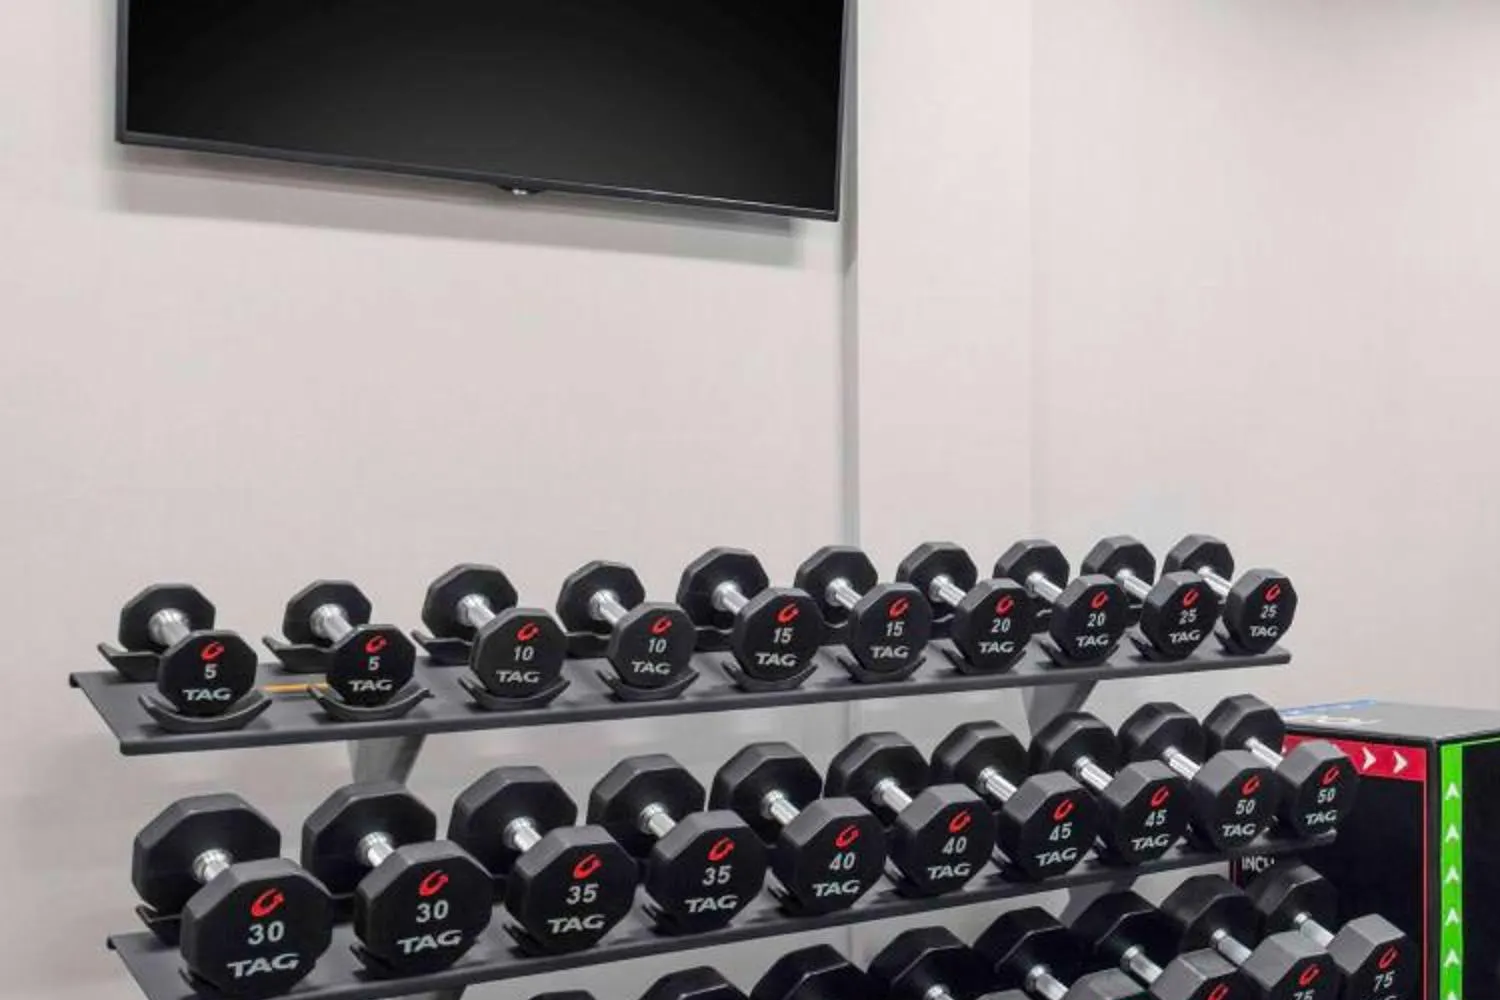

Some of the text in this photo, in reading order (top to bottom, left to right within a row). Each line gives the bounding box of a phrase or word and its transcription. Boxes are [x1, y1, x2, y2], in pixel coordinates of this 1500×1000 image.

[1179, 608, 1196, 624] 25
[1260, 604, 1277, 619] 25
[991, 618, 1010, 632] 20
[1088, 612, 1106, 627] 20
[774, 628, 793, 643] 15
[887, 621, 904, 636] 15
[1250, 626, 1278, 639] TAG
[1076, 634, 1108, 647] TAG
[1169, 630, 1201, 644] TAG
[515, 646, 534, 660] 10
[649, 639, 666, 653] 10
[871, 646, 908, 658] TAG
[980, 642, 1013, 653] TAG
[369, 653, 380, 670] 5
[756, 653, 796, 666] TAG
[205, 664, 216, 679] 5
[632, 661, 670, 674] TAG
[496, 671, 539, 682] TAG
[349, 679, 392, 691] TAG
[183, 688, 230, 700] TAG
[1318, 788, 1335, 803] 50
[1236, 799, 1255, 815] 50
[1145, 809, 1167, 827] 45
[1306, 810, 1336, 825] TAG
[1049, 822, 1072, 841] 45
[1223, 824, 1255, 836] TAG
[942, 836, 967, 854] 40
[1132, 834, 1170, 850] TAG
[829, 852, 855, 870] 40
[1036, 848, 1078, 866] TAG
[703, 865, 731, 885] 35
[928, 863, 972, 879] TAG
[566, 883, 598, 904] 35
[813, 880, 861, 897] TAG
[416, 900, 448, 922] 30
[685, 895, 738, 913] TAG
[548, 914, 604, 933] TAG
[248, 921, 284, 944] 30
[397, 930, 461, 953] TAG
[227, 954, 298, 977] TAG
[1374, 970, 1394, 992] 75
